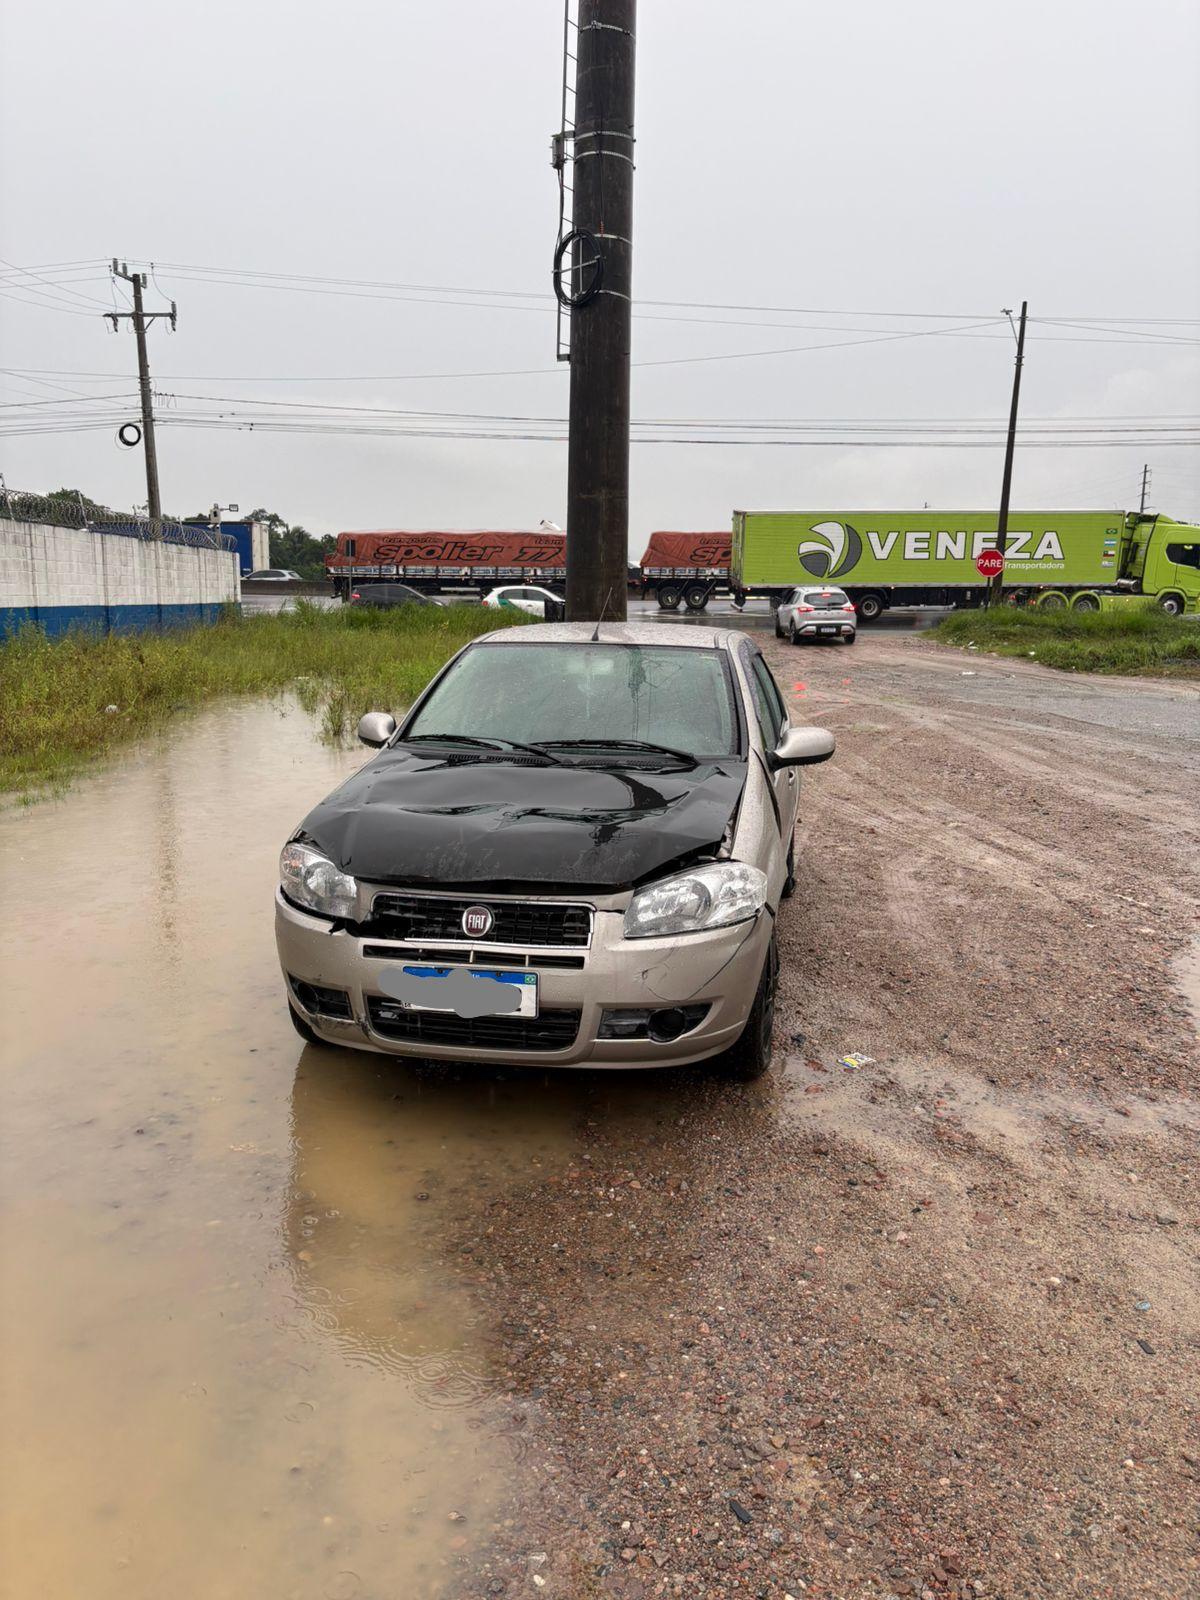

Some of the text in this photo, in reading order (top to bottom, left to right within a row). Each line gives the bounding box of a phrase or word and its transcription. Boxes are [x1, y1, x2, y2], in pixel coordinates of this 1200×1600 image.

[374, 541, 563, 563] spolier 77
[866, 531, 1065, 560] VENEZA
[977, 559, 1002, 568] PARE
[1004, 561, 1065, 570] Transportadora
[467, 914, 487, 930] FIAT
